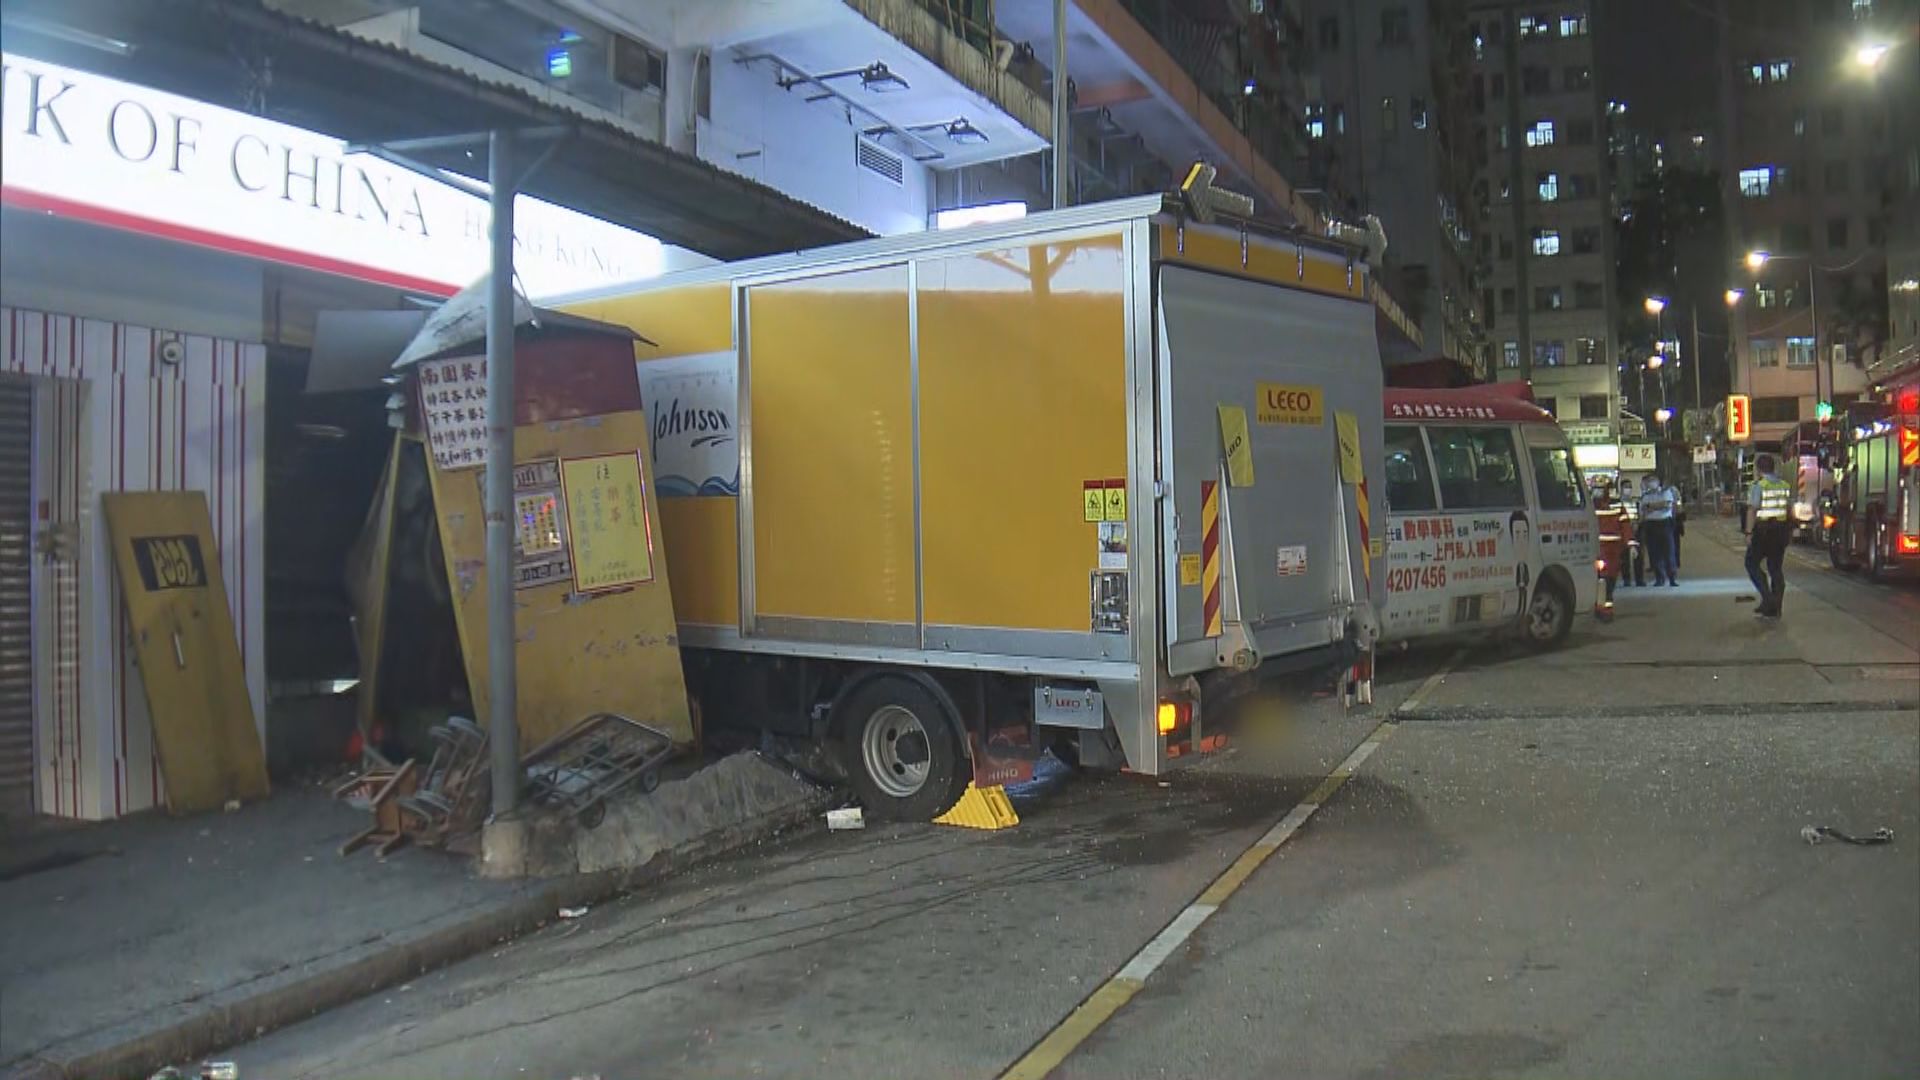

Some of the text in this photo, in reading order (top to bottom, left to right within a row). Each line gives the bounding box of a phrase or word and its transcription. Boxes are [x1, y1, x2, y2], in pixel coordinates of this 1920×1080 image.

[4, 66, 430, 237] K OF CHINA
[653, 398, 731, 463] Johnson
[1268, 389, 1311, 412] LEEO
